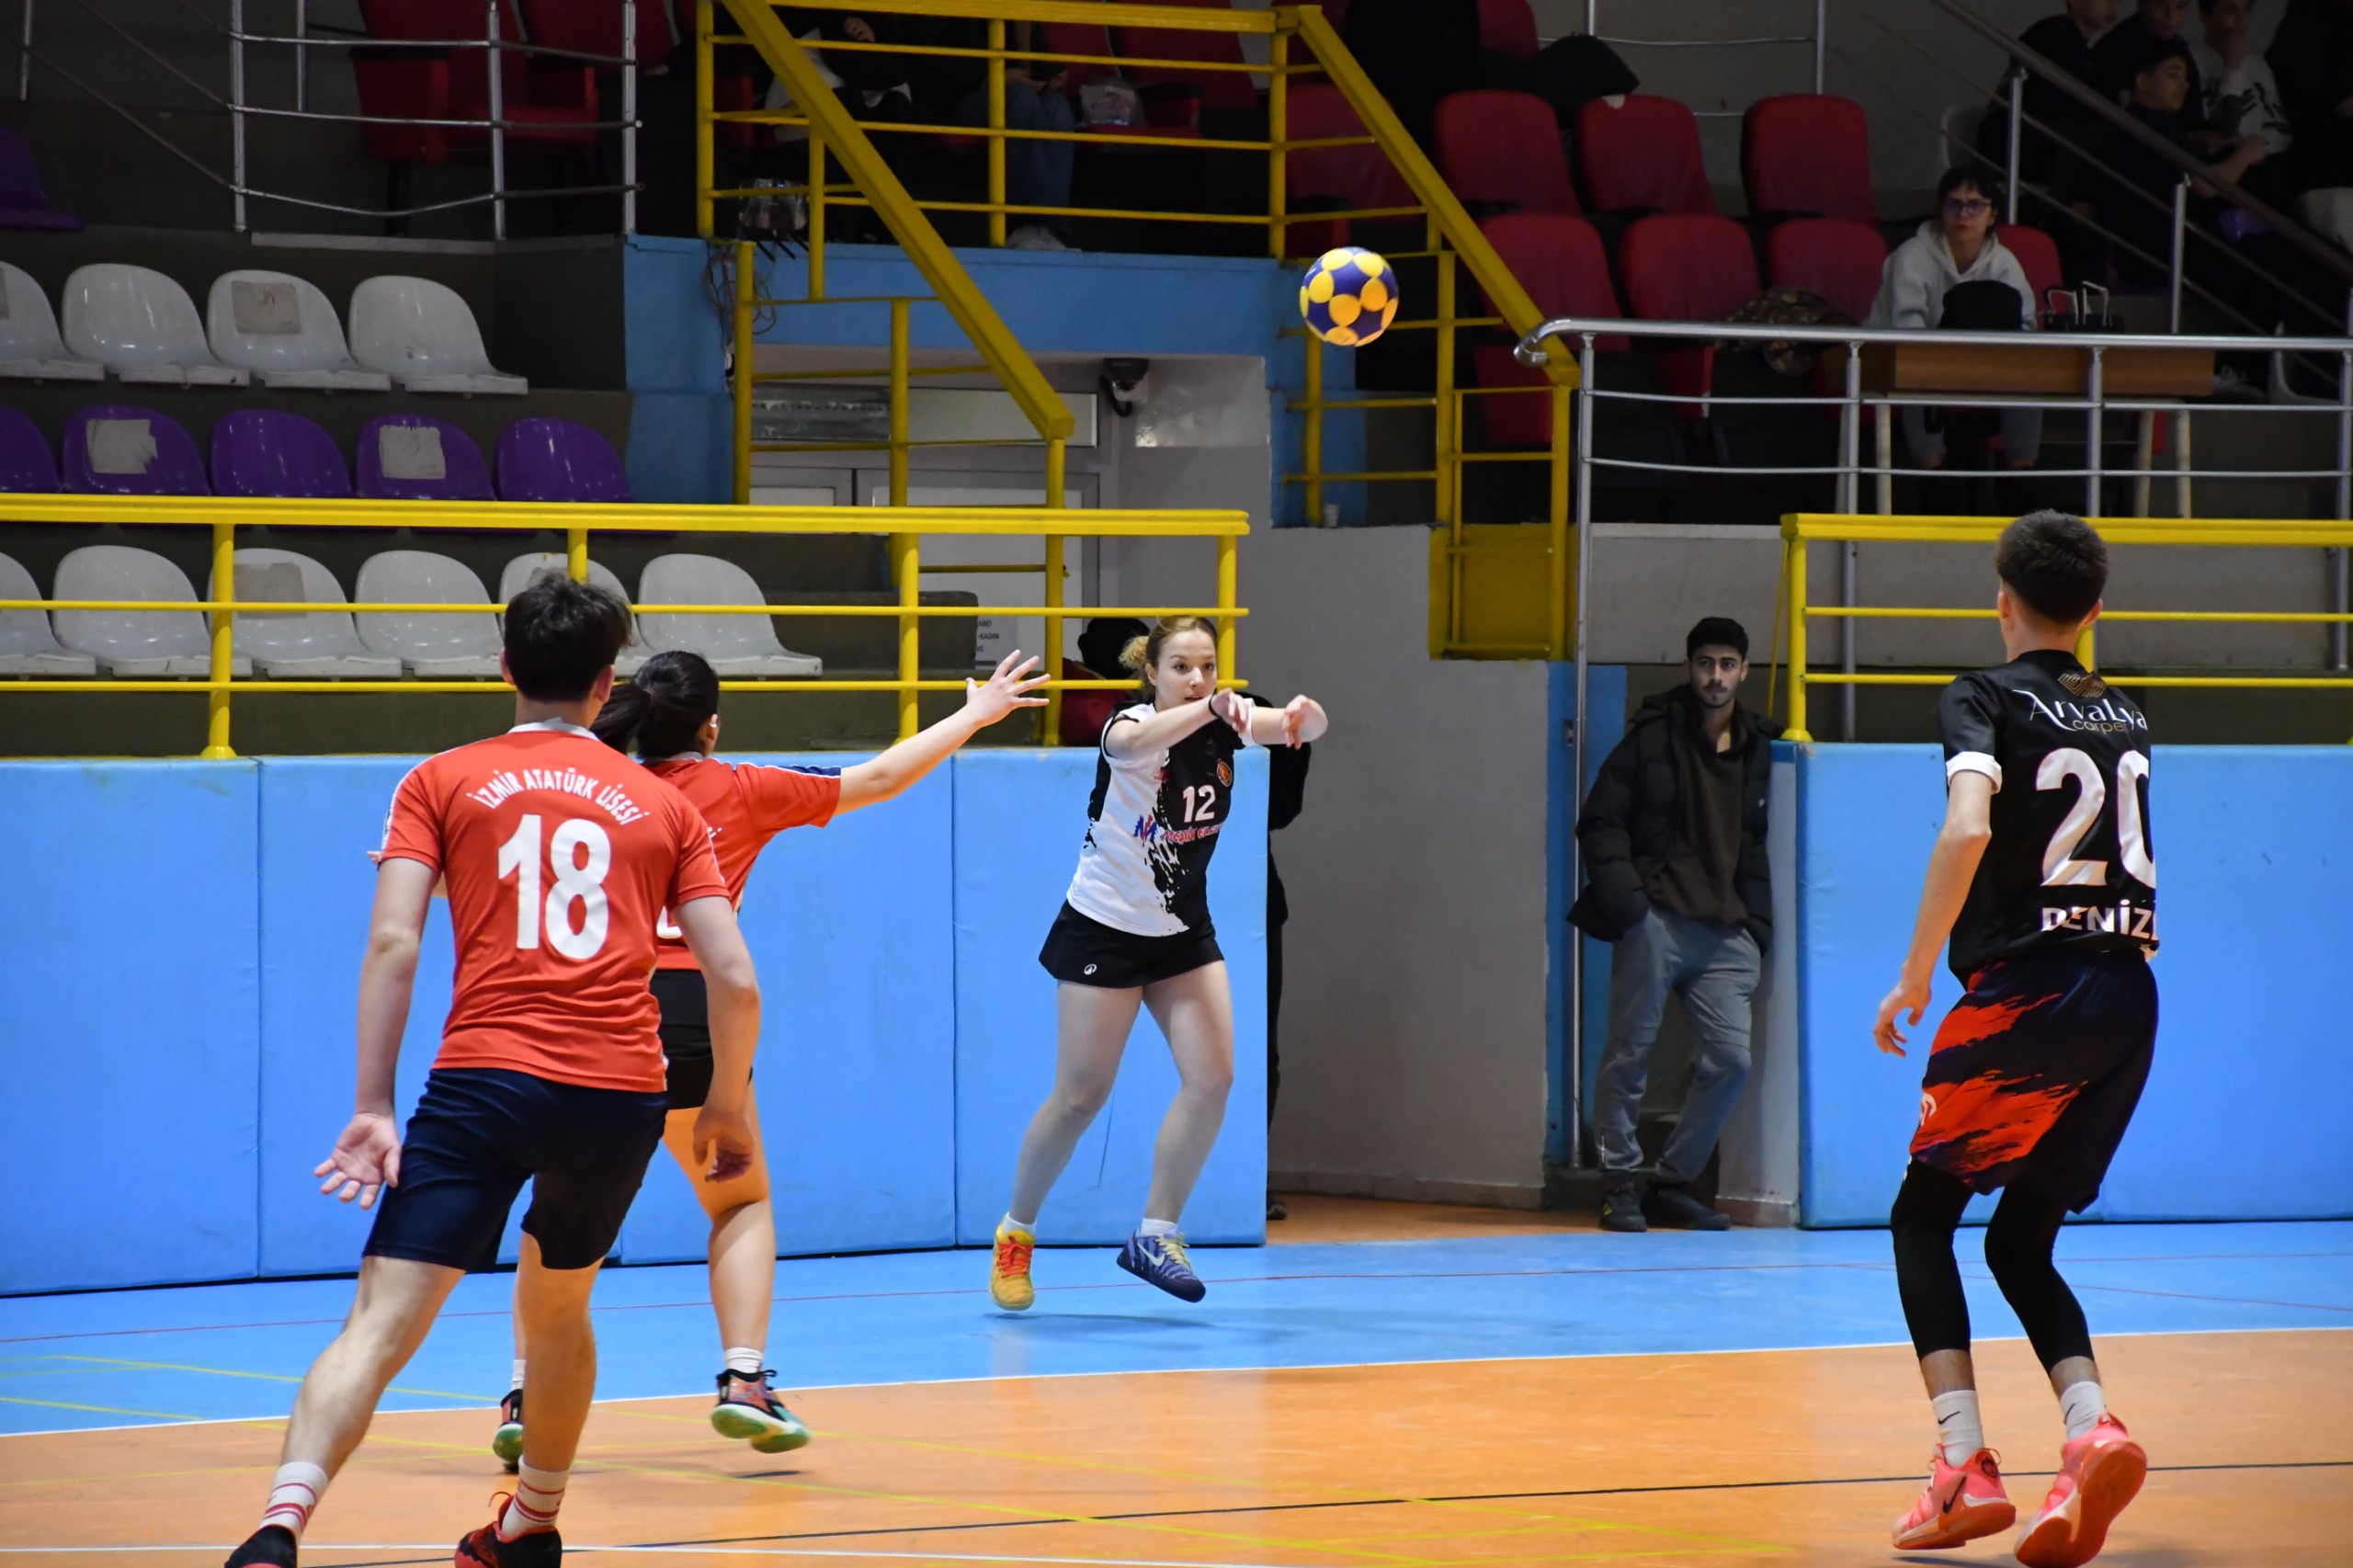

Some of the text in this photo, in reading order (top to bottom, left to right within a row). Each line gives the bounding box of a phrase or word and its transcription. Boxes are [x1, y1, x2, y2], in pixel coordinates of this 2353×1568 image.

[466, 767, 651, 825] İZMİR ATATÜRK LİSESİ
[1182, 784, 1216, 823] 12
[2036, 747, 2156, 889] 20
[497, 813, 611, 960] 18
